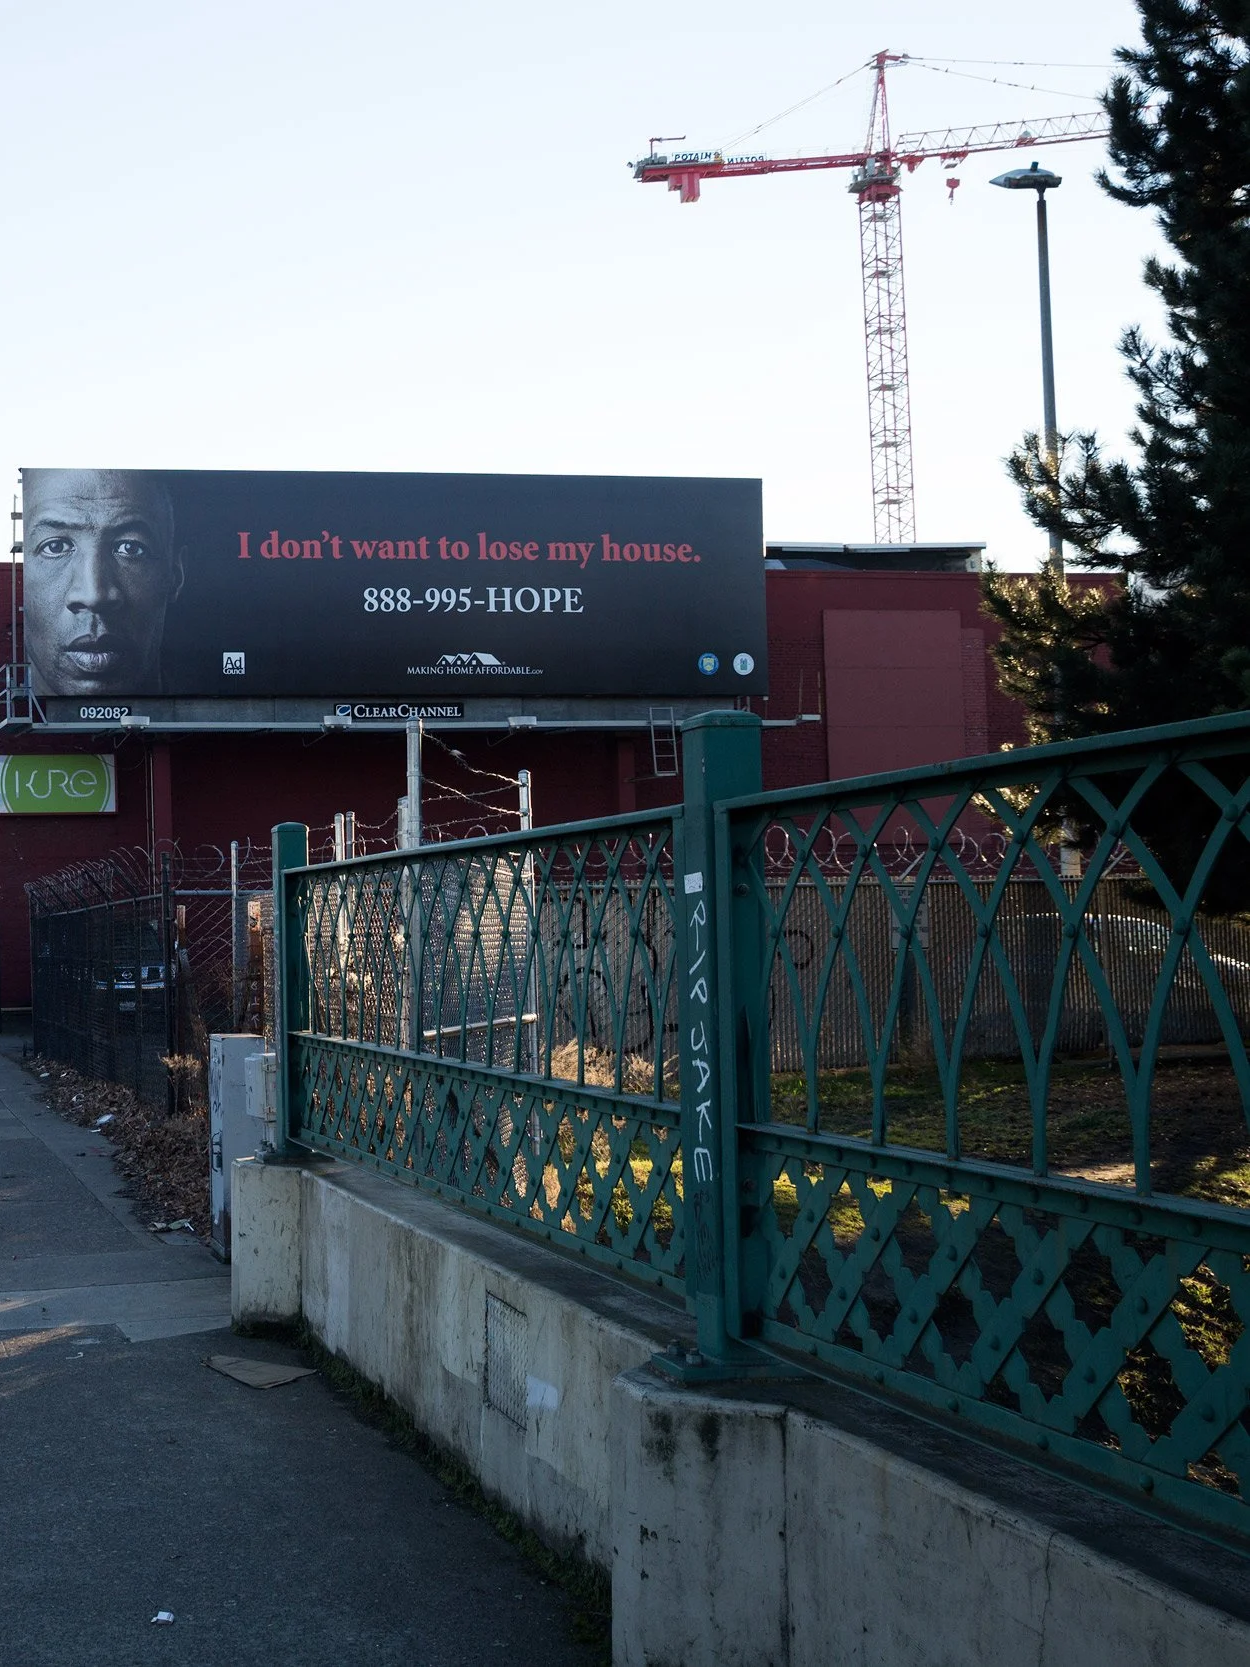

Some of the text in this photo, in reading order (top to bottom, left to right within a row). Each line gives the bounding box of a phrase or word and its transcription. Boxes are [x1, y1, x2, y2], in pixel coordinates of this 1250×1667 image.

[237, 530, 702, 569] I don't want to lose my house.
[362, 586, 585, 614] 888-995-HOPE
[224, 656, 242, 668] Ad
[406, 666, 444, 675] MAKING
[446, 666, 474, 675] HOME
[79, 706, 129, 719] 092082
[690, 1021, 714, 1183] JAKE
